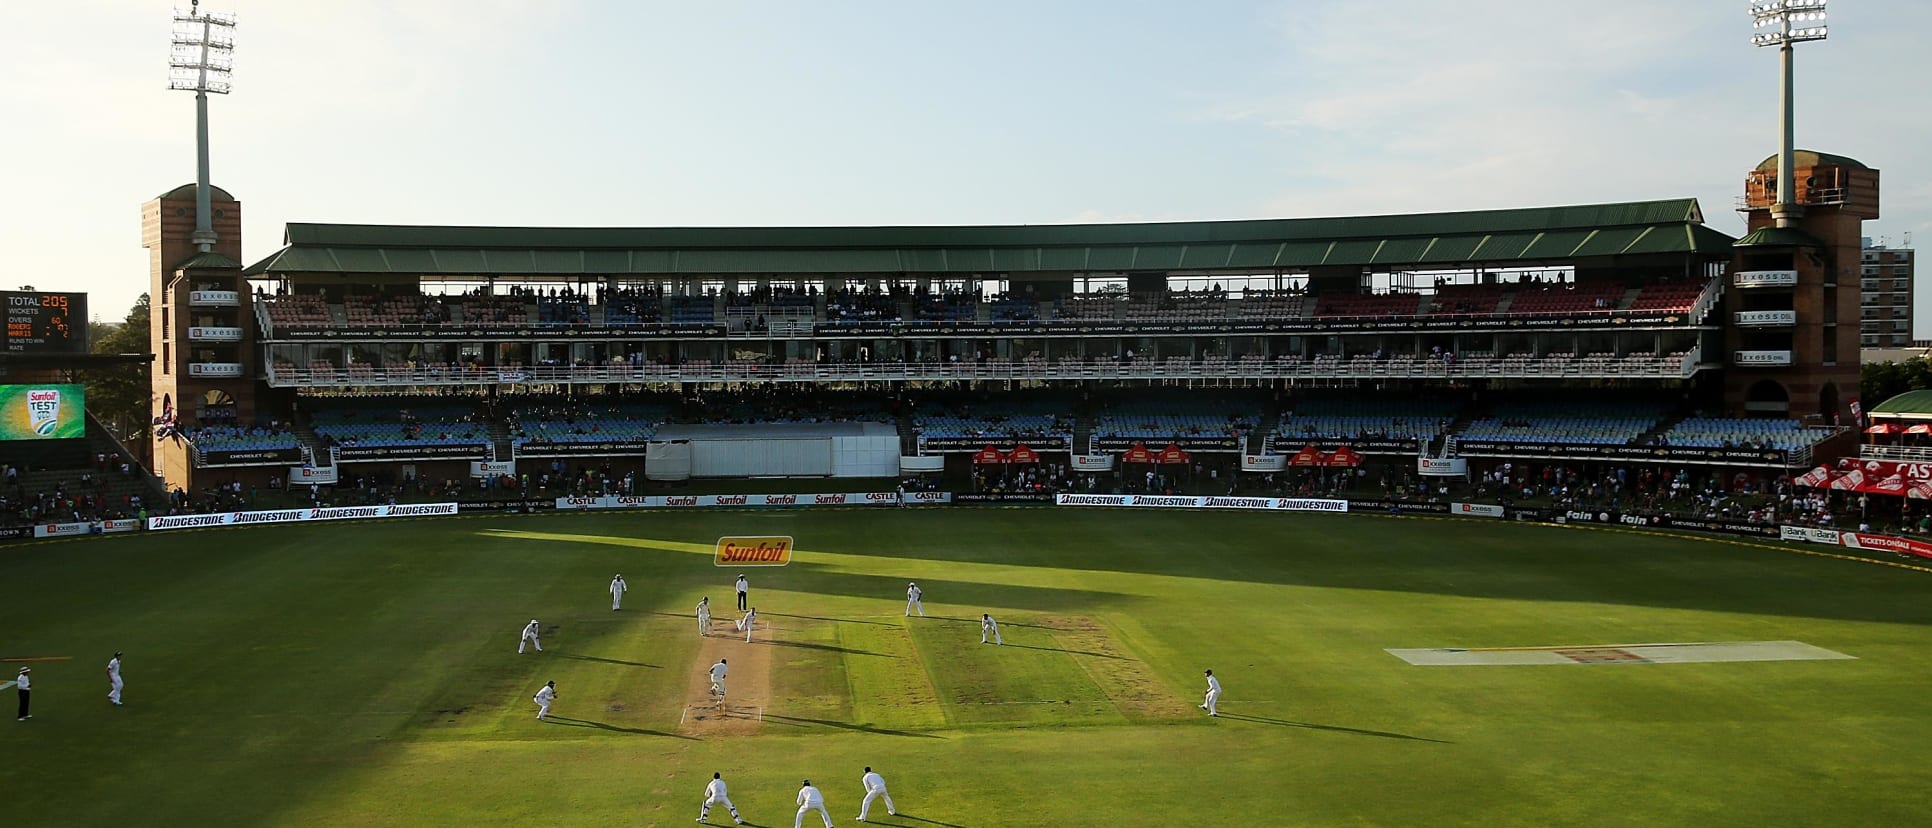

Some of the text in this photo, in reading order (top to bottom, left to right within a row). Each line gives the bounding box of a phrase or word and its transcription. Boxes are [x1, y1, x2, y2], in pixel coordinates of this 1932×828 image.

[8, 296, 68, 306] TOTAL 205
[61, 307, 68, 316] 7
[31, 392, 56, 401] Sunfoil
[30, 402, 56, 410] TEST
[666, 494, 846, 506] Sunfoil Sunfoil Sunfoil Sunfoil
[1860, 537, 1885, 545] TICKETS
[721, 542, 787, 561] Sunfoil
